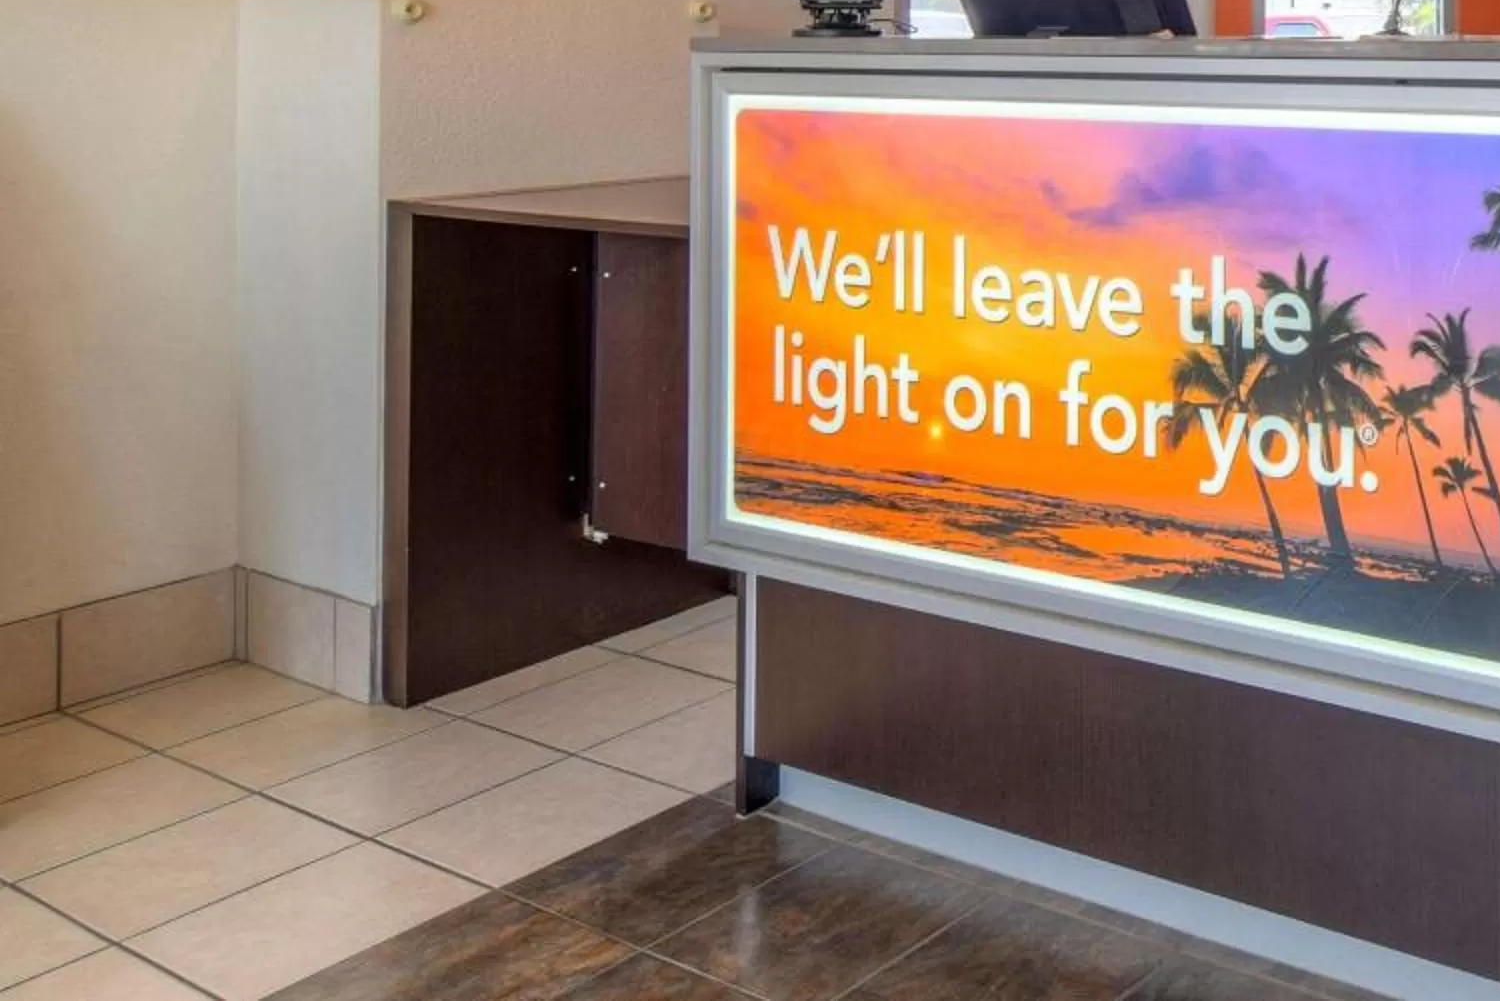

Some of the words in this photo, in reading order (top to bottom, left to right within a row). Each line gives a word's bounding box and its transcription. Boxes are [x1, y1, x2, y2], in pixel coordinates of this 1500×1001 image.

[767, 224, 926, 313] We'll
[953, 234, 1144, 337] leave
[1169, 254, 1314, 357] the
[774, 324, 920, 435] light
[943, 373, 1032, 439] on
[1059, 358, 1174, 458] for
